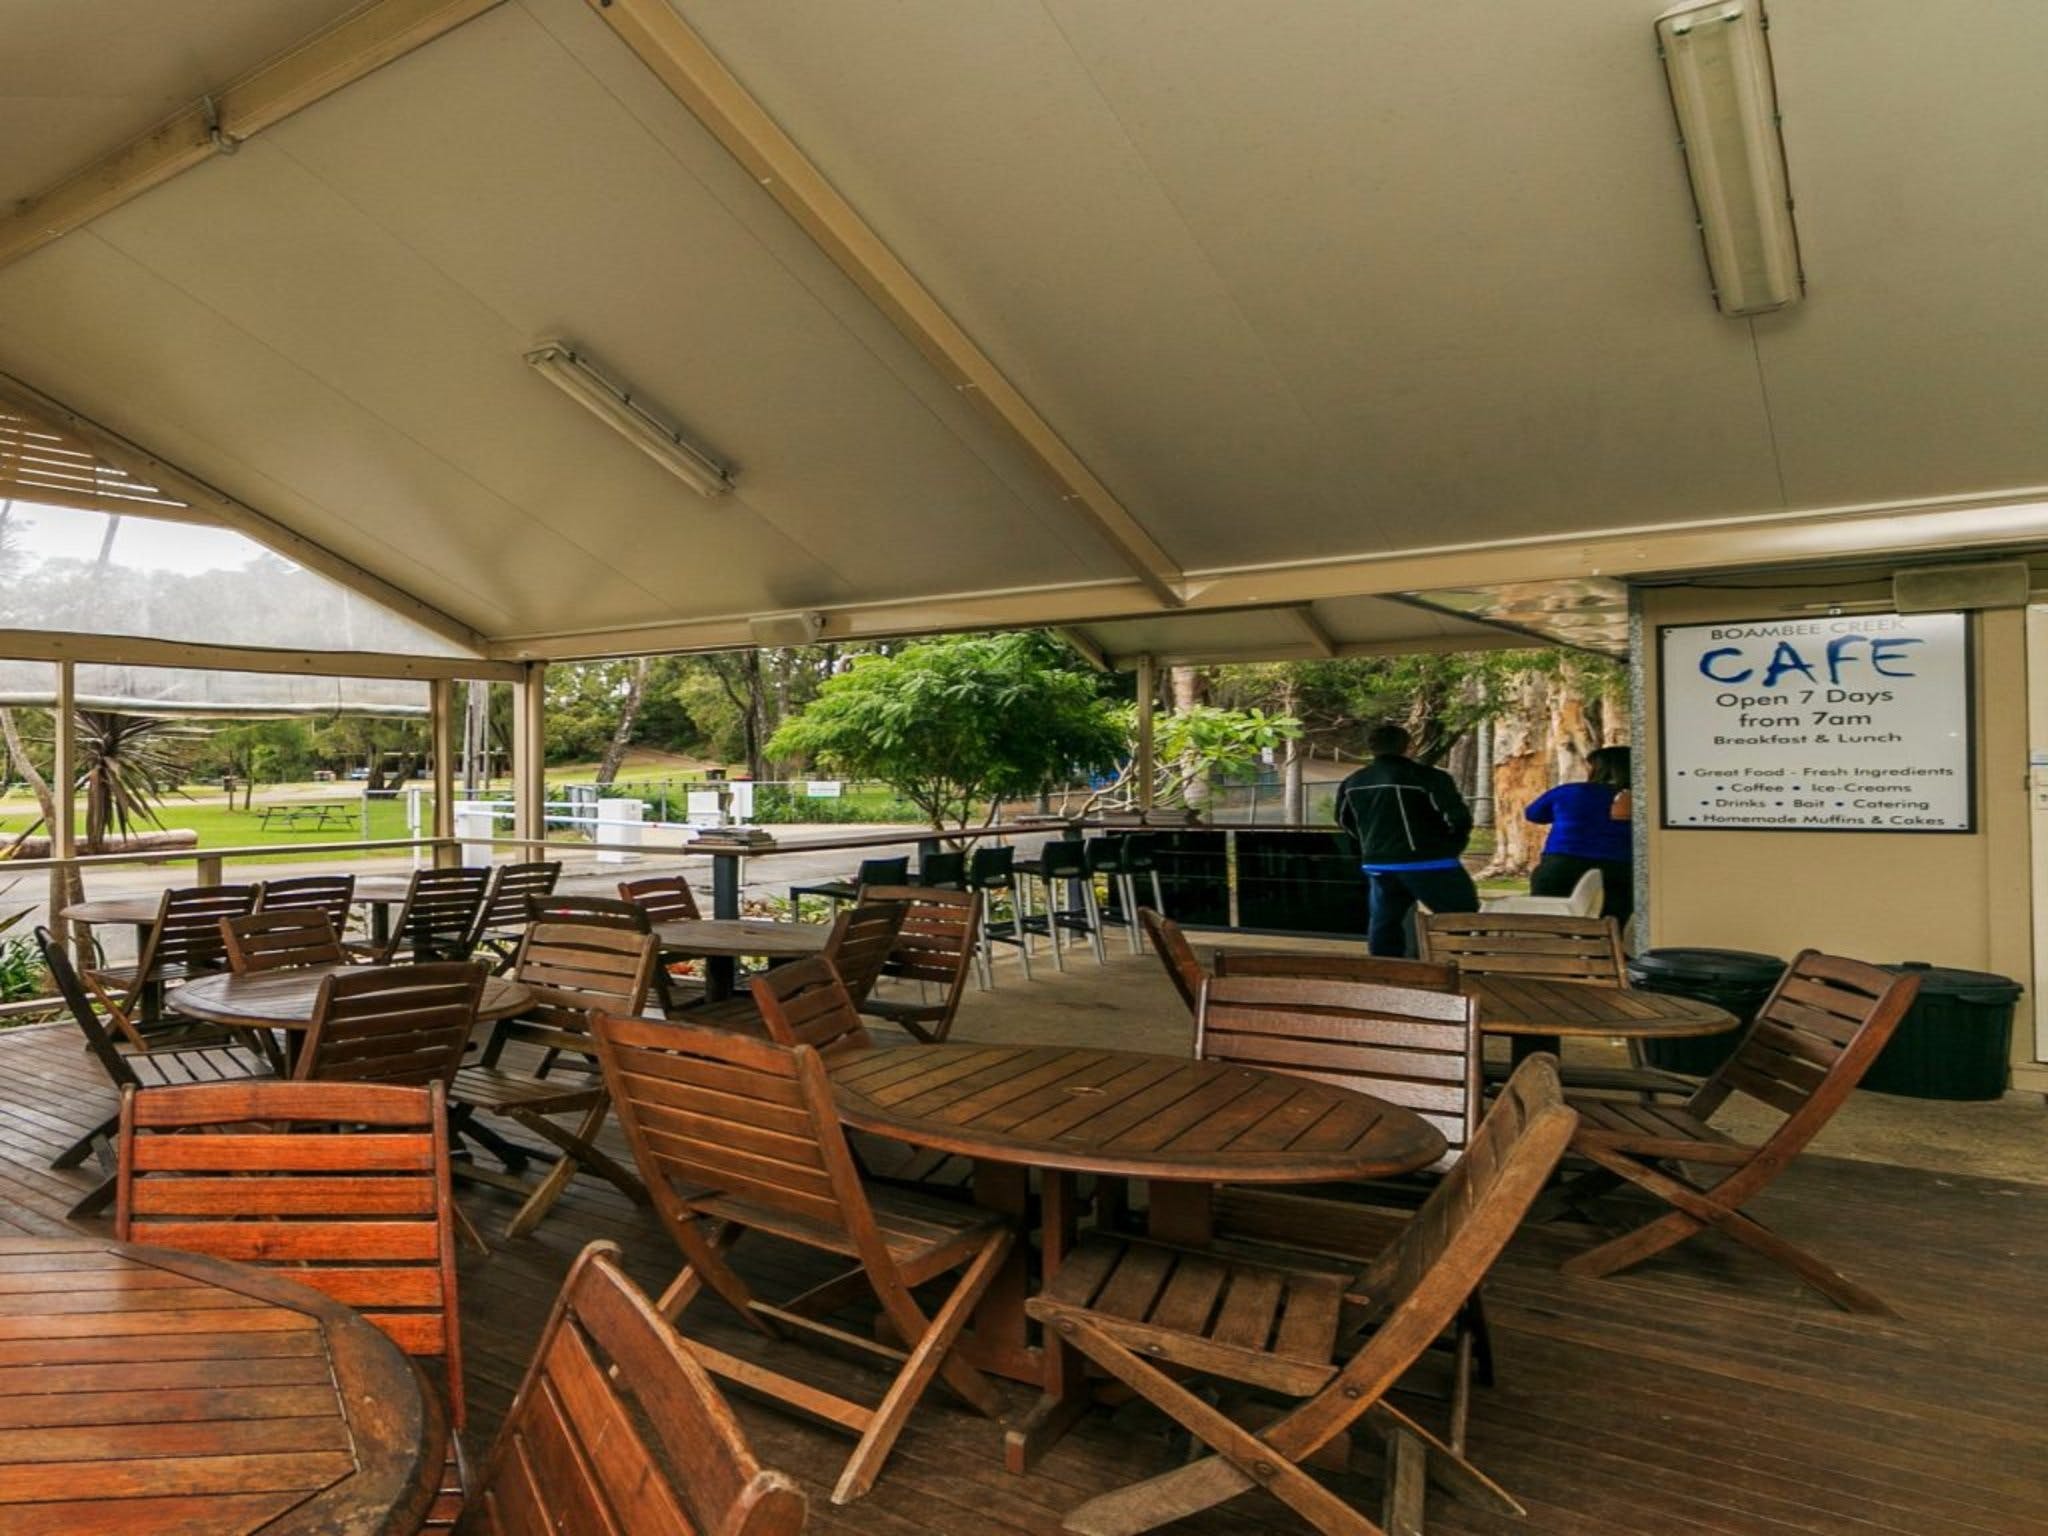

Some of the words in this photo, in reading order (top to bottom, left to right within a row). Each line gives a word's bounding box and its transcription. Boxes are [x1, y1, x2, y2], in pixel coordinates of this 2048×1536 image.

[1711, 623, 1820, 641] BOAMBEE
[1830, 618, 1905, 634] CREEK
[1699, 634, 1924, 687] CAFE
[1716, 693, 1788, 709] Open
[1799, 691, 1814, 704] 7
[1827, 689, 1894, 705] Days
[1739, 714, 1799, 728] from
[1812, 712, 1872, 726] 7am
[1714, 735, 1807, 745] Breakfast
[1815, 734, 1830, 743] &
[1838, 733, 1902, 743] Lunch
[1694, 768, 1738, 777] Great
[1745, 769, 1784, 777] Food
[1804, 768, 1848, 776] Fresh
[1855, 767, 1953, 778] Ingredients
[1731, 783, 1784, 792] Coffee
[1812, 784, 1912, 792] Ice-Creams
[1715, 799, 1766, 808] Drinks
[1793, 800, 1824, 808] Bait
[1853, 800, 1930, 810] Catering
[1704, 814, 1796, 823] Homemade
[1803, 814, 1864, 825] Muffins
[1871, 816, 1883, 825] &
[1890, 816, 1945, 825] Cakes
